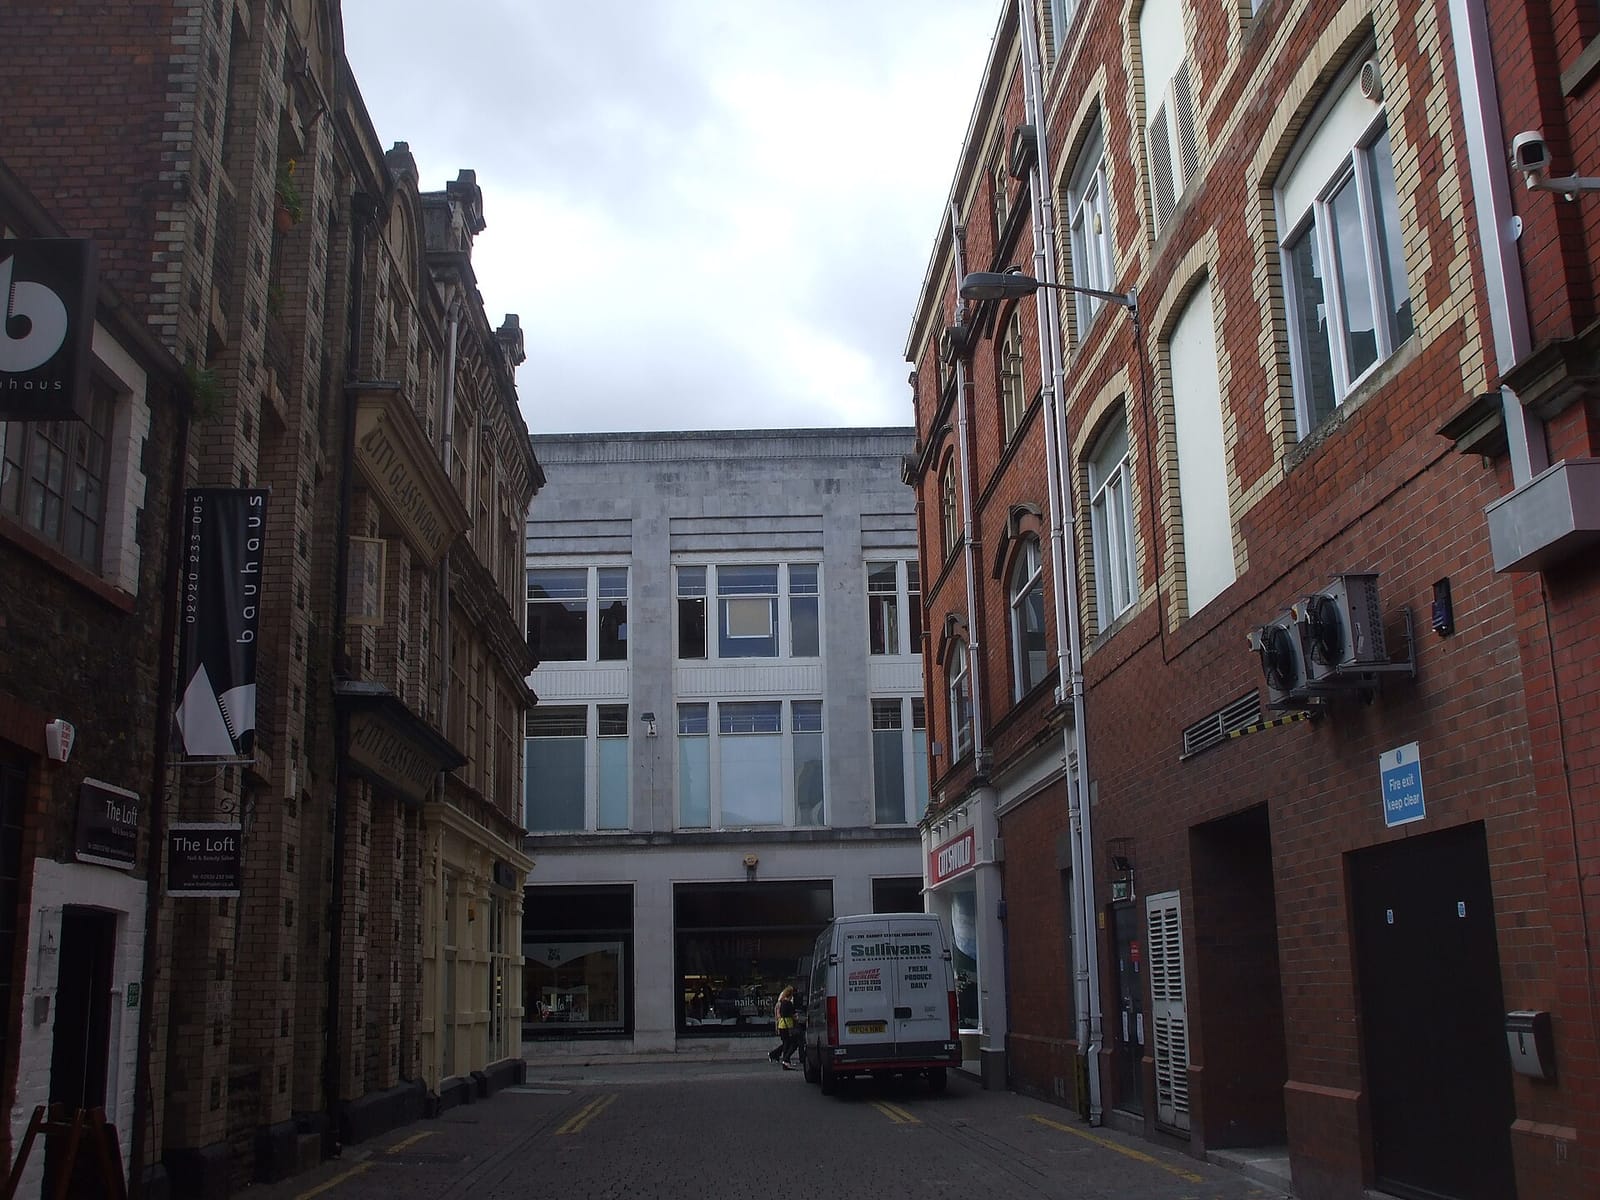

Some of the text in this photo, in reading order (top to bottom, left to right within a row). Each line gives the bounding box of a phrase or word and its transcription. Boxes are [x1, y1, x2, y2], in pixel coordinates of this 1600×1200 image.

[365, 427, 445, 551] CITY GLASS WORKS
[186, 495, 204, 624] 02920 233 005
[236, 495, 263, 644] bauhaus
[1388, 773, 1415, 792] Fire exit
[1386, 792, 1420, 812] keep clear
[106, 799, 138, 826] The Loft
[173, 836, 235, 852] The Loft
[938, 836, 971, 878] COTSWOLD
[851, 942, 932, 957] Sullivans
[904, 973, 932, 981] PRODUCE
[908, 965, 928, 973] FRESH
[911, 982, 928, 990] DAILY
[735, 995, 755, 1007] nails
